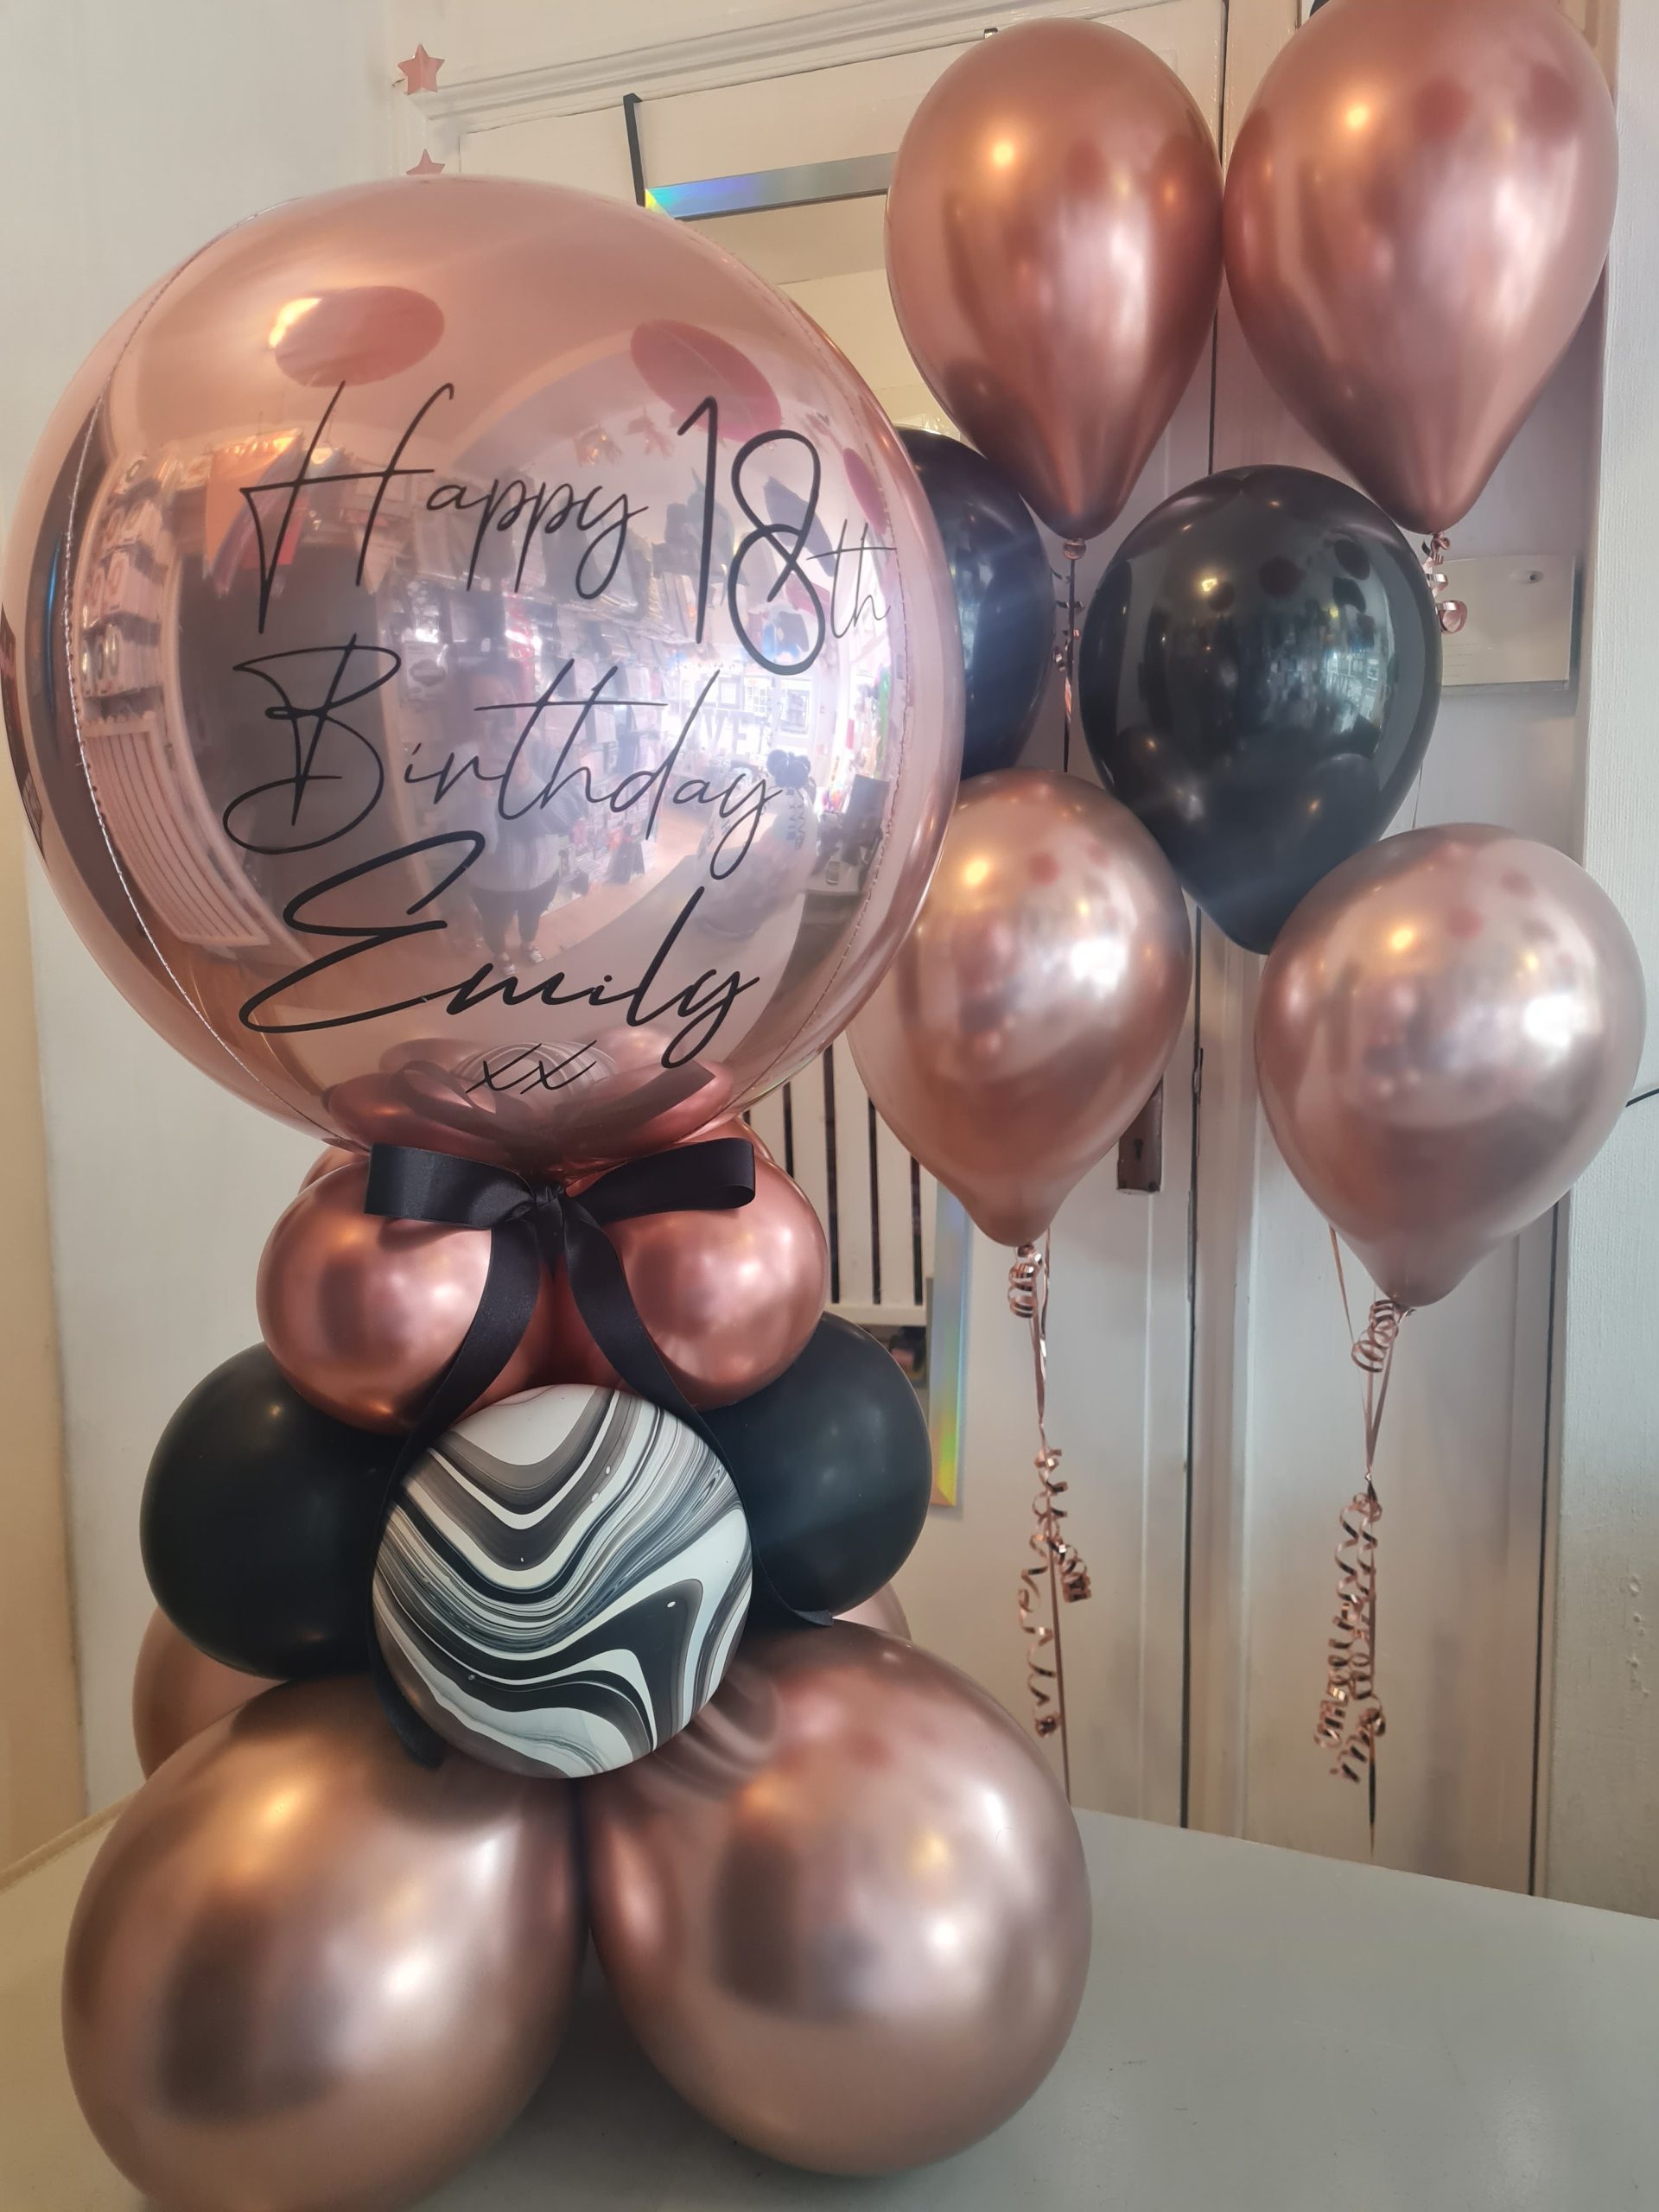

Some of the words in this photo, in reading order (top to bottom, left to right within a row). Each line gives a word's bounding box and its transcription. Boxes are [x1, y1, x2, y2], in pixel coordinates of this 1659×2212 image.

[239, 381, 649, 633] Happy
[222, 634, 782, 880] Birthday
[239, 830, 760, 1069] Emily
